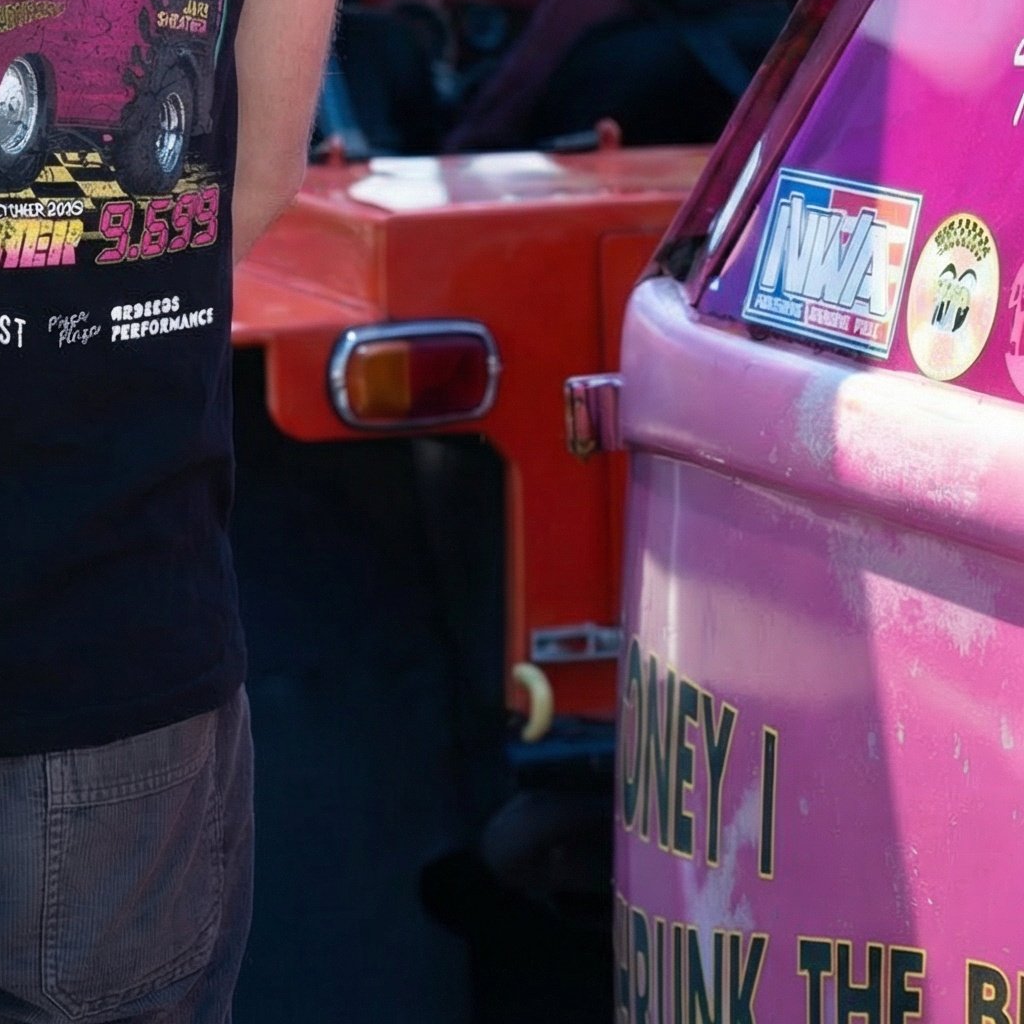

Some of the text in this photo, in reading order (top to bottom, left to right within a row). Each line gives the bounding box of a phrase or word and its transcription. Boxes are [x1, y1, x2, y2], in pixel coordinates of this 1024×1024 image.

[759, 189, 890, 317] NWA
[110, 307, 214, 343] PERFORMANCE
[758, 723, 779, 880] I
[796, 935, 927, 1024] THE
[965, 958, 1024, 1024] B
